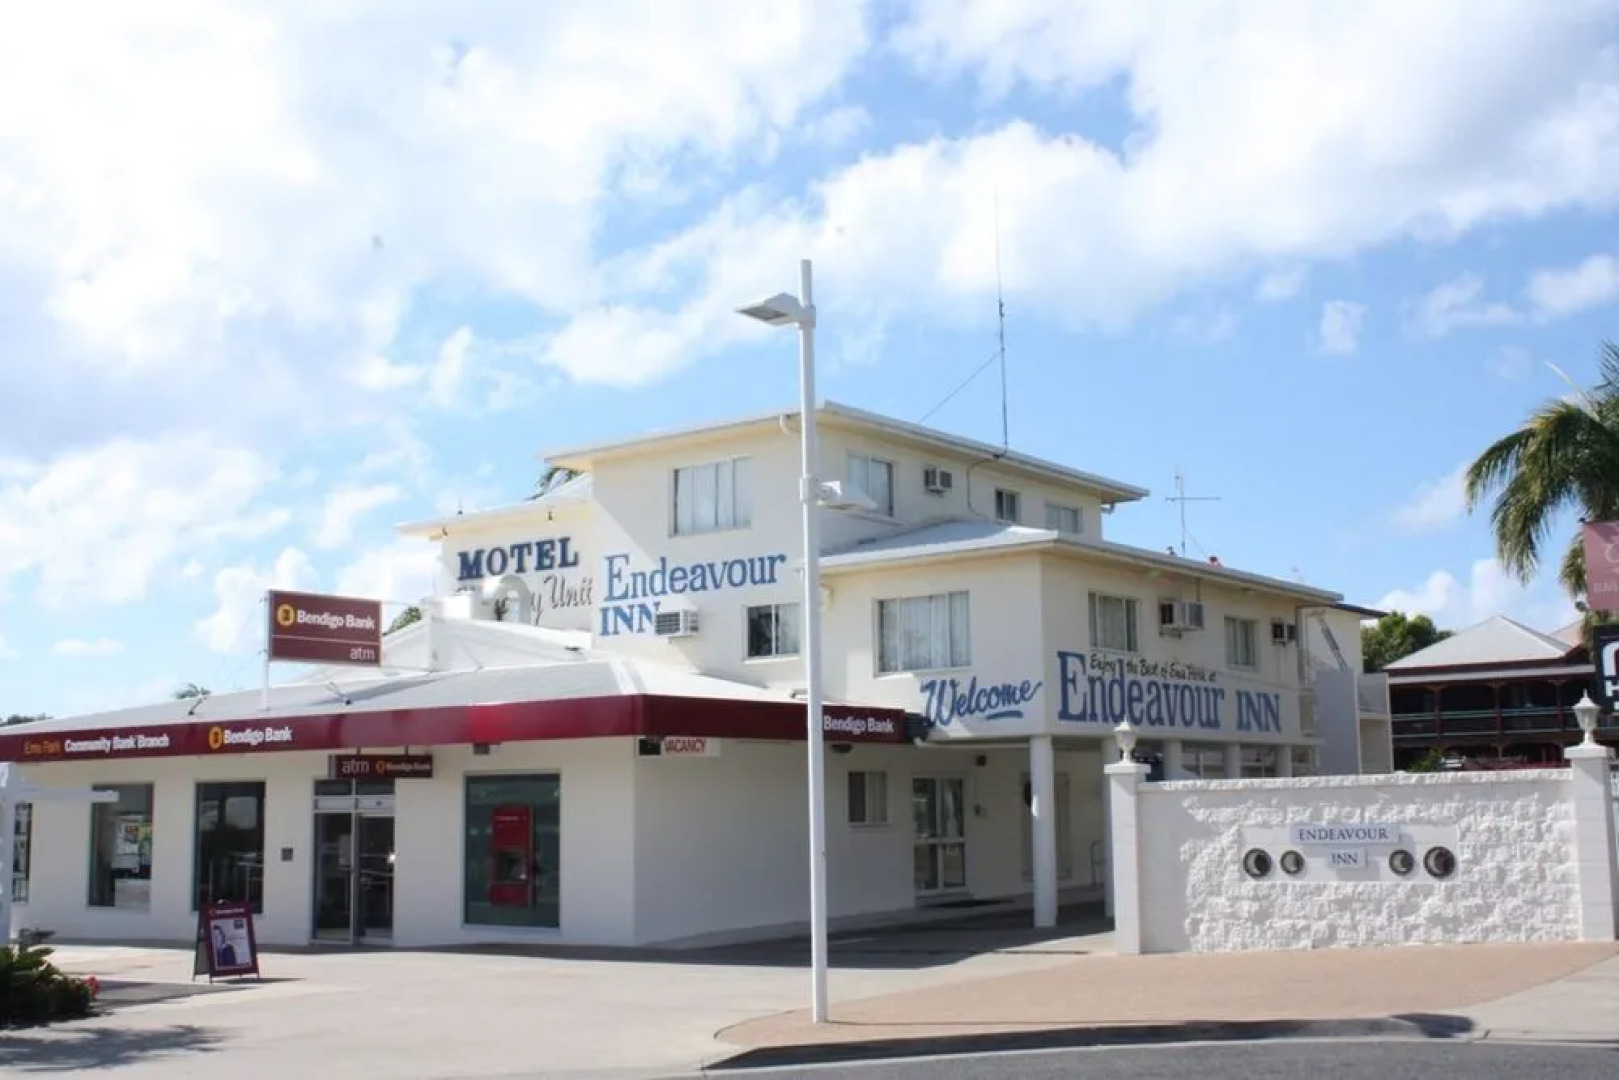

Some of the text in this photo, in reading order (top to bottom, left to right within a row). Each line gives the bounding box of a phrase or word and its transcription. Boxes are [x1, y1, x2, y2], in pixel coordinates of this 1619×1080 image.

[458, 537, 579, 580] MOTEL
[603, 554, 787, 601] Endeavour
[297, 610, 375, 629] Bendigo Bank
[600, 601, 660, 635] INN
[350, 647, 375, 660] atm
[920, 675, 1042, 726] Welcome
[1059, 651, 1282, 733] Endeavour INN
[823, 715, 894, 734] Bendigo Bank
[224, 727, 292, 745] Bendigo Bank
[65, 738, 111, 753] Community
[665, 738, 706, 754] VACANCY
[342, 759, 370, 774] atm
[1298, 828, 1389, 841] ENDEAVOUR
[1330, 852, 1358, 864] INN
